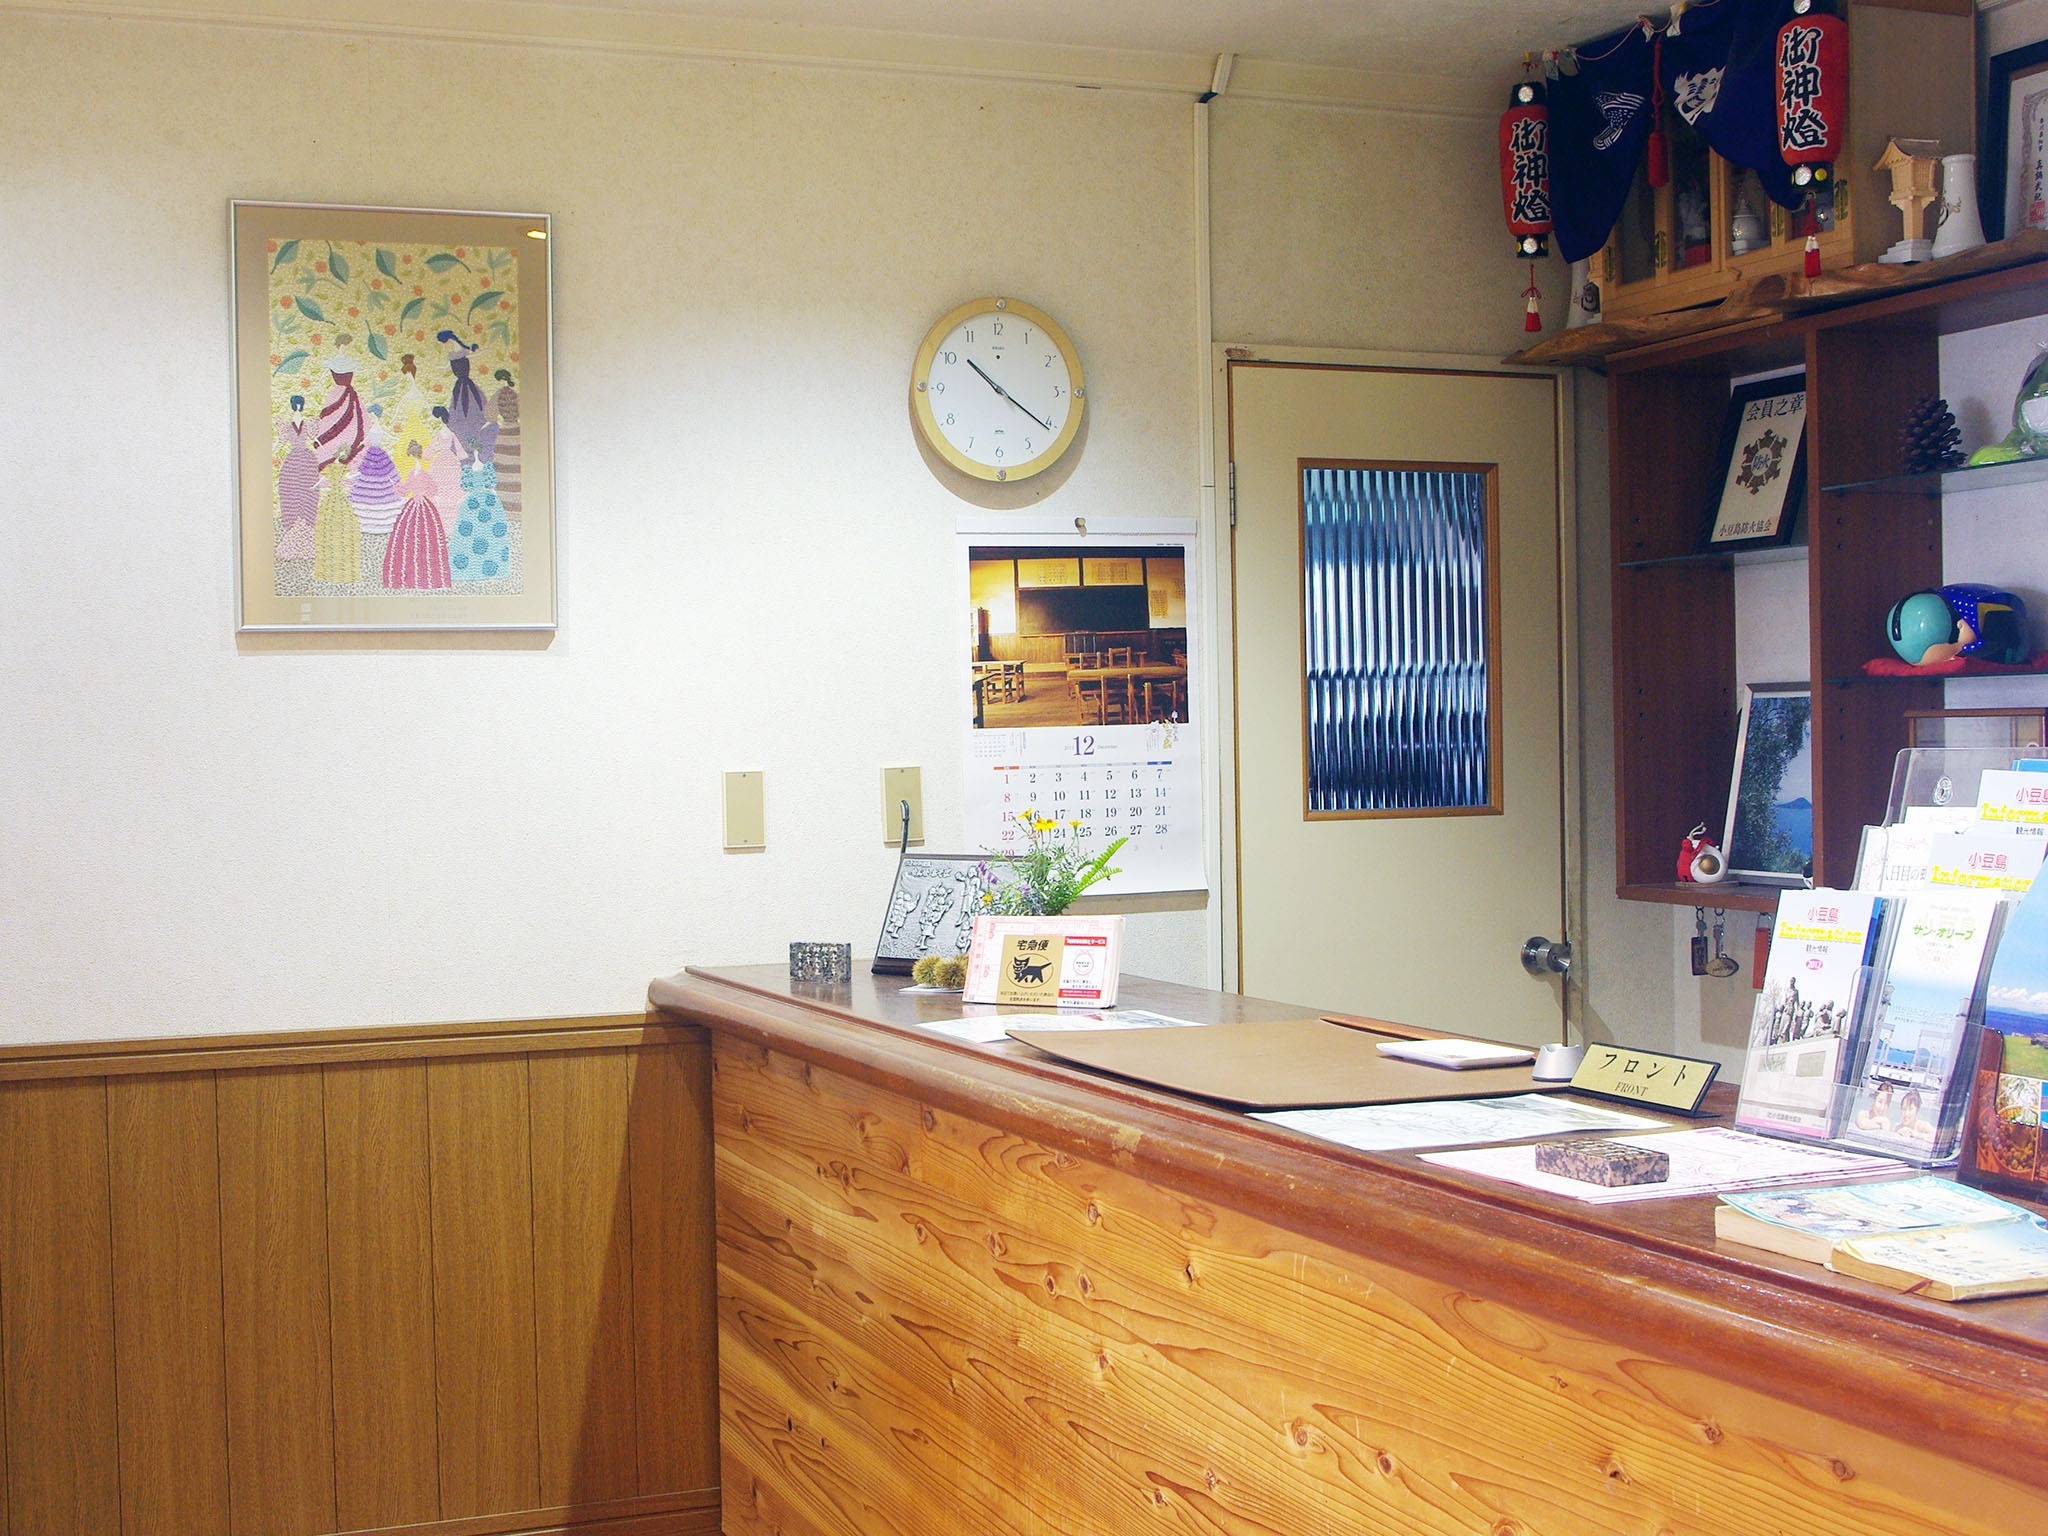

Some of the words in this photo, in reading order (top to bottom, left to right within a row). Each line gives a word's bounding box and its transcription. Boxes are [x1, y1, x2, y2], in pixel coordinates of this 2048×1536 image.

[966, 329, 974, 343] 11
[993, 321, 1004, 336] 12
[944, 350, 957, 365] 10
[1044, 354, 1052, 368] 2
[936, 382, 946, 396] 9
[1053, 385, 1060, 399] 3
[946, 412, 956, 425] 8
[1045, 414, 1053, 428] 4
[968, 435, 975, 450] 7
[1024, 437, 1032, 450] 5
[994, 445, 1004, 459] 6
[1752, 454, 1771, 470] 防火
[1073, 735, 1095, 756] 12
[1004, 774, 1009, 785] 1
[1028, 773, 1037, 784] 2
[1054, 772, 1062, 782] 3
[1080, 771, 1088, 781] 4
[1106, 770, 1113, 780] 5
[1131, 769, 1139, 779] 6
[1156, 768, 1164, 779] 7
[1003, 793, 1010, 803] 8
[1029, 791, 1037, 802] 9
[1054, 791, 1066, 801] 10
[1079, 790, 1090, 800] 11
[1105, 789, 1117, 799] 12
[1130, 788, 1142, 799] 13
[1155, 787, 1167, 798] 14
[1002, 811, 1014, 822] 15
[1054, 809, 1066, 820] 17
[1079, 809, 1092, 819] 18
[1105, 808, 1117, 818] 19
[1130, 807, 1142, 817] 20
[1155, 805, 1167, 816] 21
[1001, 830, 1015, 841] 22
[1053, 828, 1066, 839] 24
[1080, 826, 1092, 838] 25
[1105, 826, 1117, 836] 26
[1130, 825, 1143, 836] 27
[1155, 823, 1168, 834] 28
[1968, 851, 2008, 869] 小豆島
[1807, 906, 1839, 923] 小豆島
[1016, 939, 1050, 951] 宅急便
[1598, 1053, 1687, 1087] フロント
[1613, 1081, 1649, 1097] FRONT
